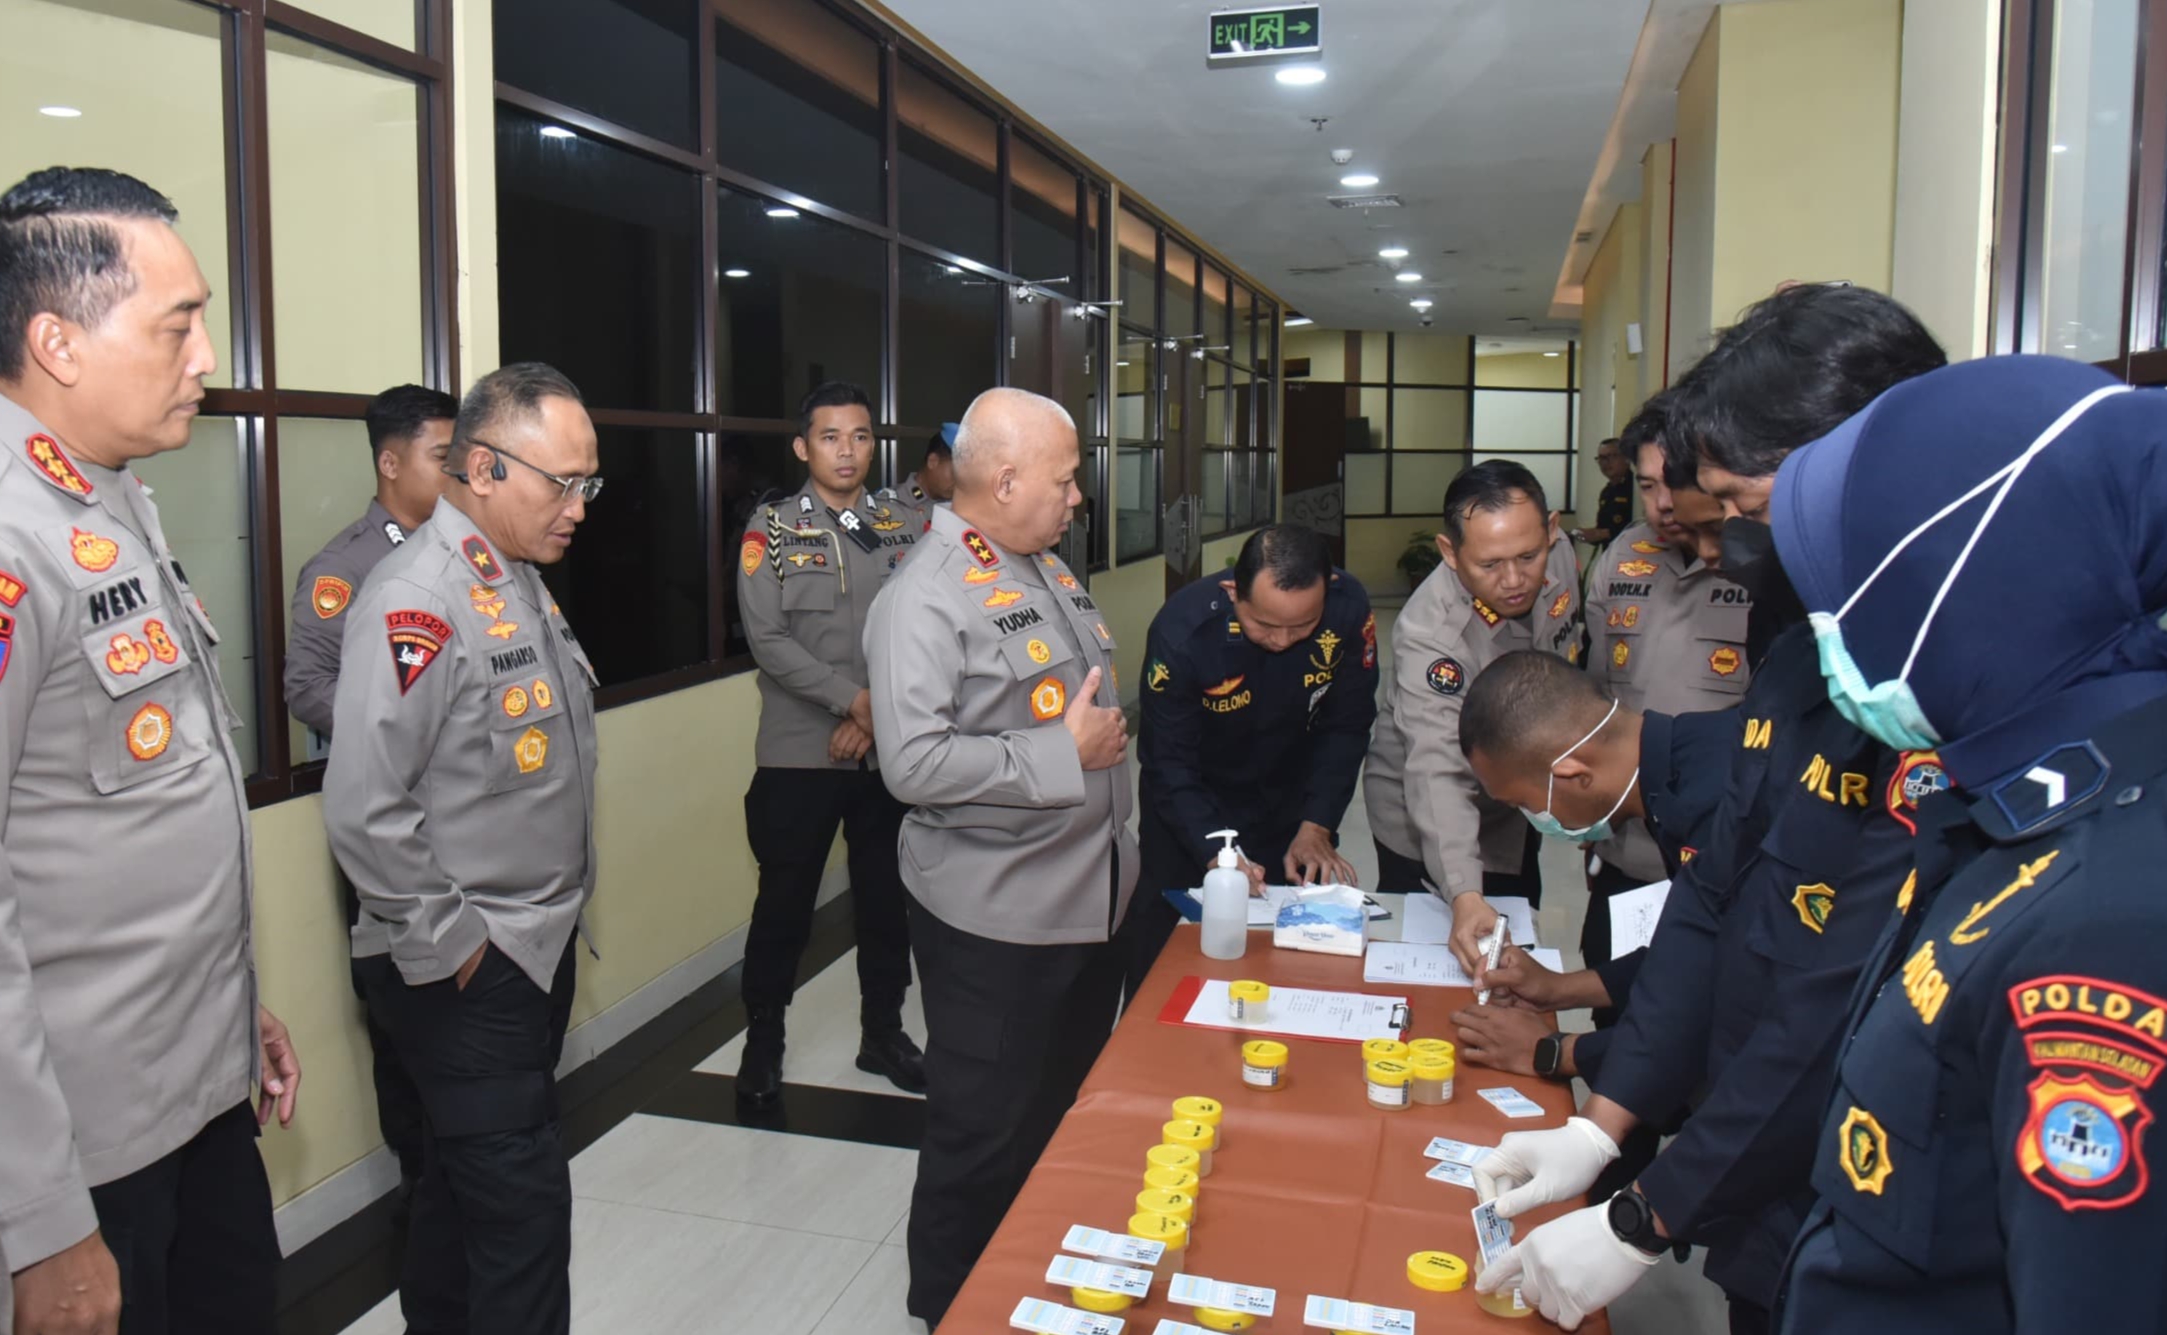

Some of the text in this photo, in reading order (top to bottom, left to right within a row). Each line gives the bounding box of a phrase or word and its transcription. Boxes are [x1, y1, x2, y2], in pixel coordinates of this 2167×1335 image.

[1215, 22, 1247, 45] EXIT
[89, 576, 148, 625] HERY
[391, 613, 447, 638] PELOPOR
[993, 606, 1044, 635] YUDHA
[490, 645, 539, 676] PANGARSO
[2021, 982, 2165, 1039] POLDA
